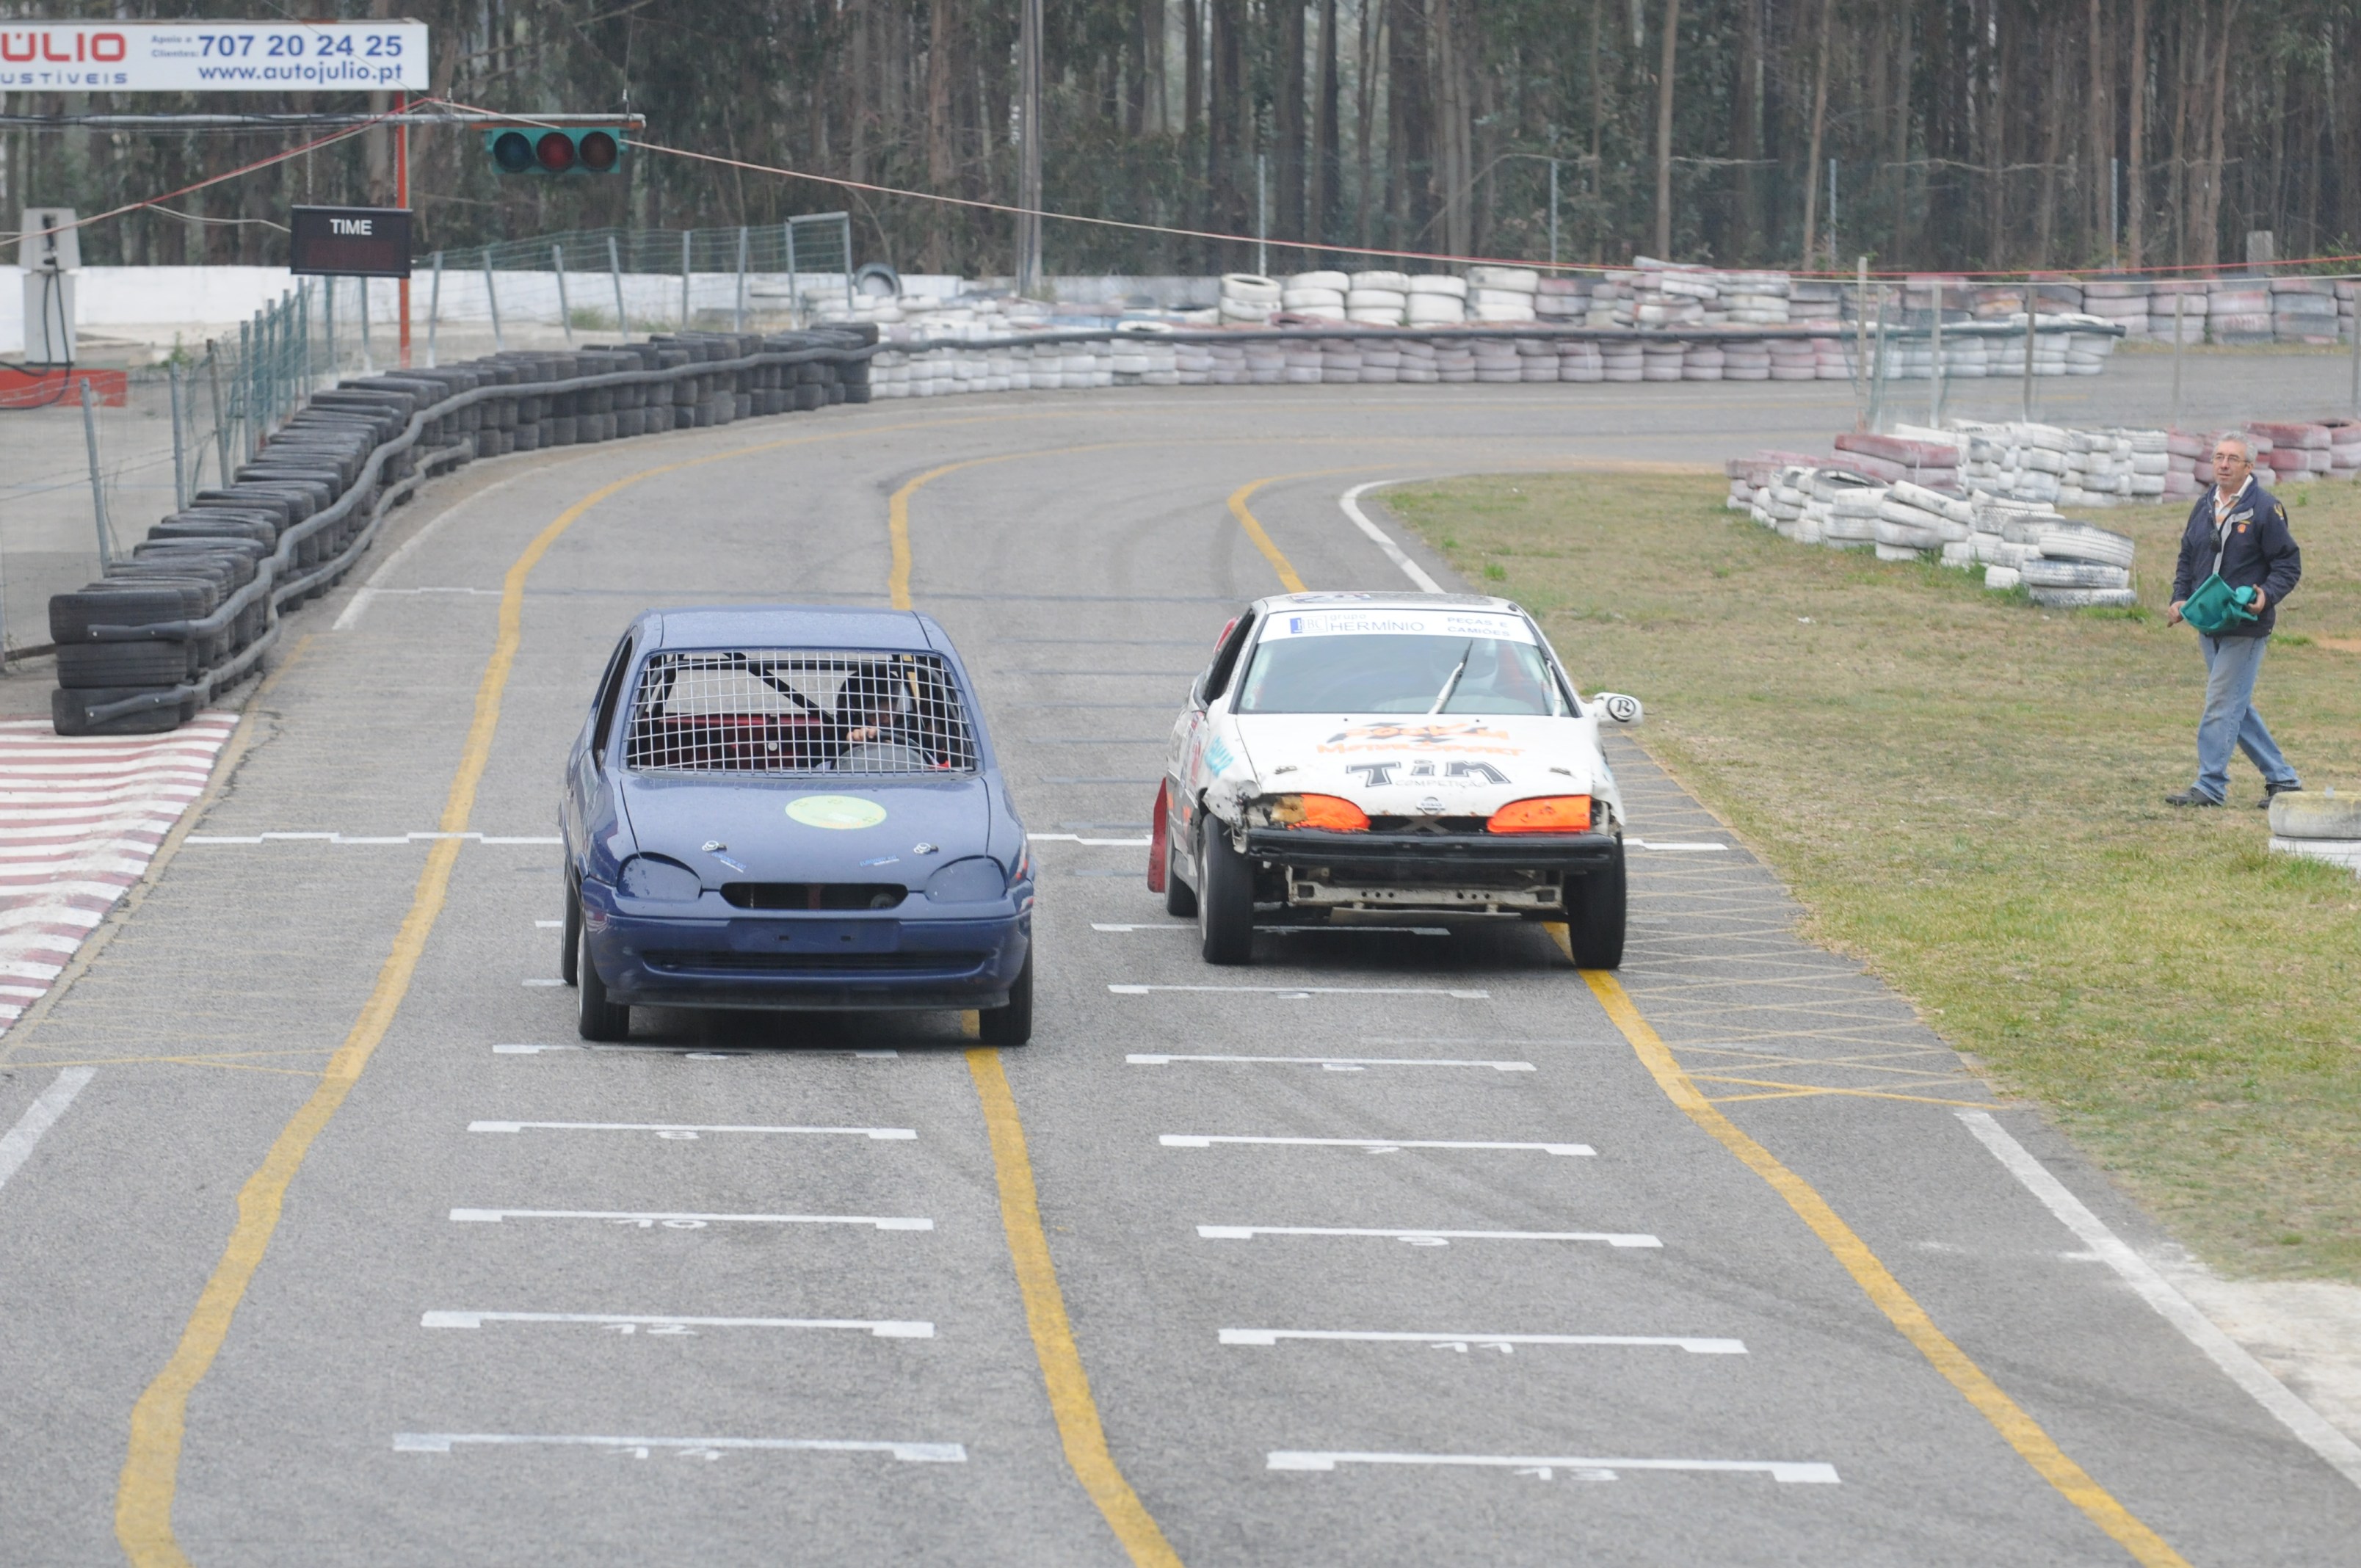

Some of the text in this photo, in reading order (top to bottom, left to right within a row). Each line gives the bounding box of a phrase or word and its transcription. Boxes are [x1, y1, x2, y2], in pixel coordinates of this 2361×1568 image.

[198, 35, 402, 57] 707 20 24 25
[198, 62, 403, 84] www.autojulio.pt
[330, 219, 372, 236] TIME
[1330, 614, 1366, 623] grupo
[1447, 617, 1493, 626] PEÇAS
[1330, 620, 1425, 632] HERMÍNIO
[1430, 1342, 1514, 1354] 11
